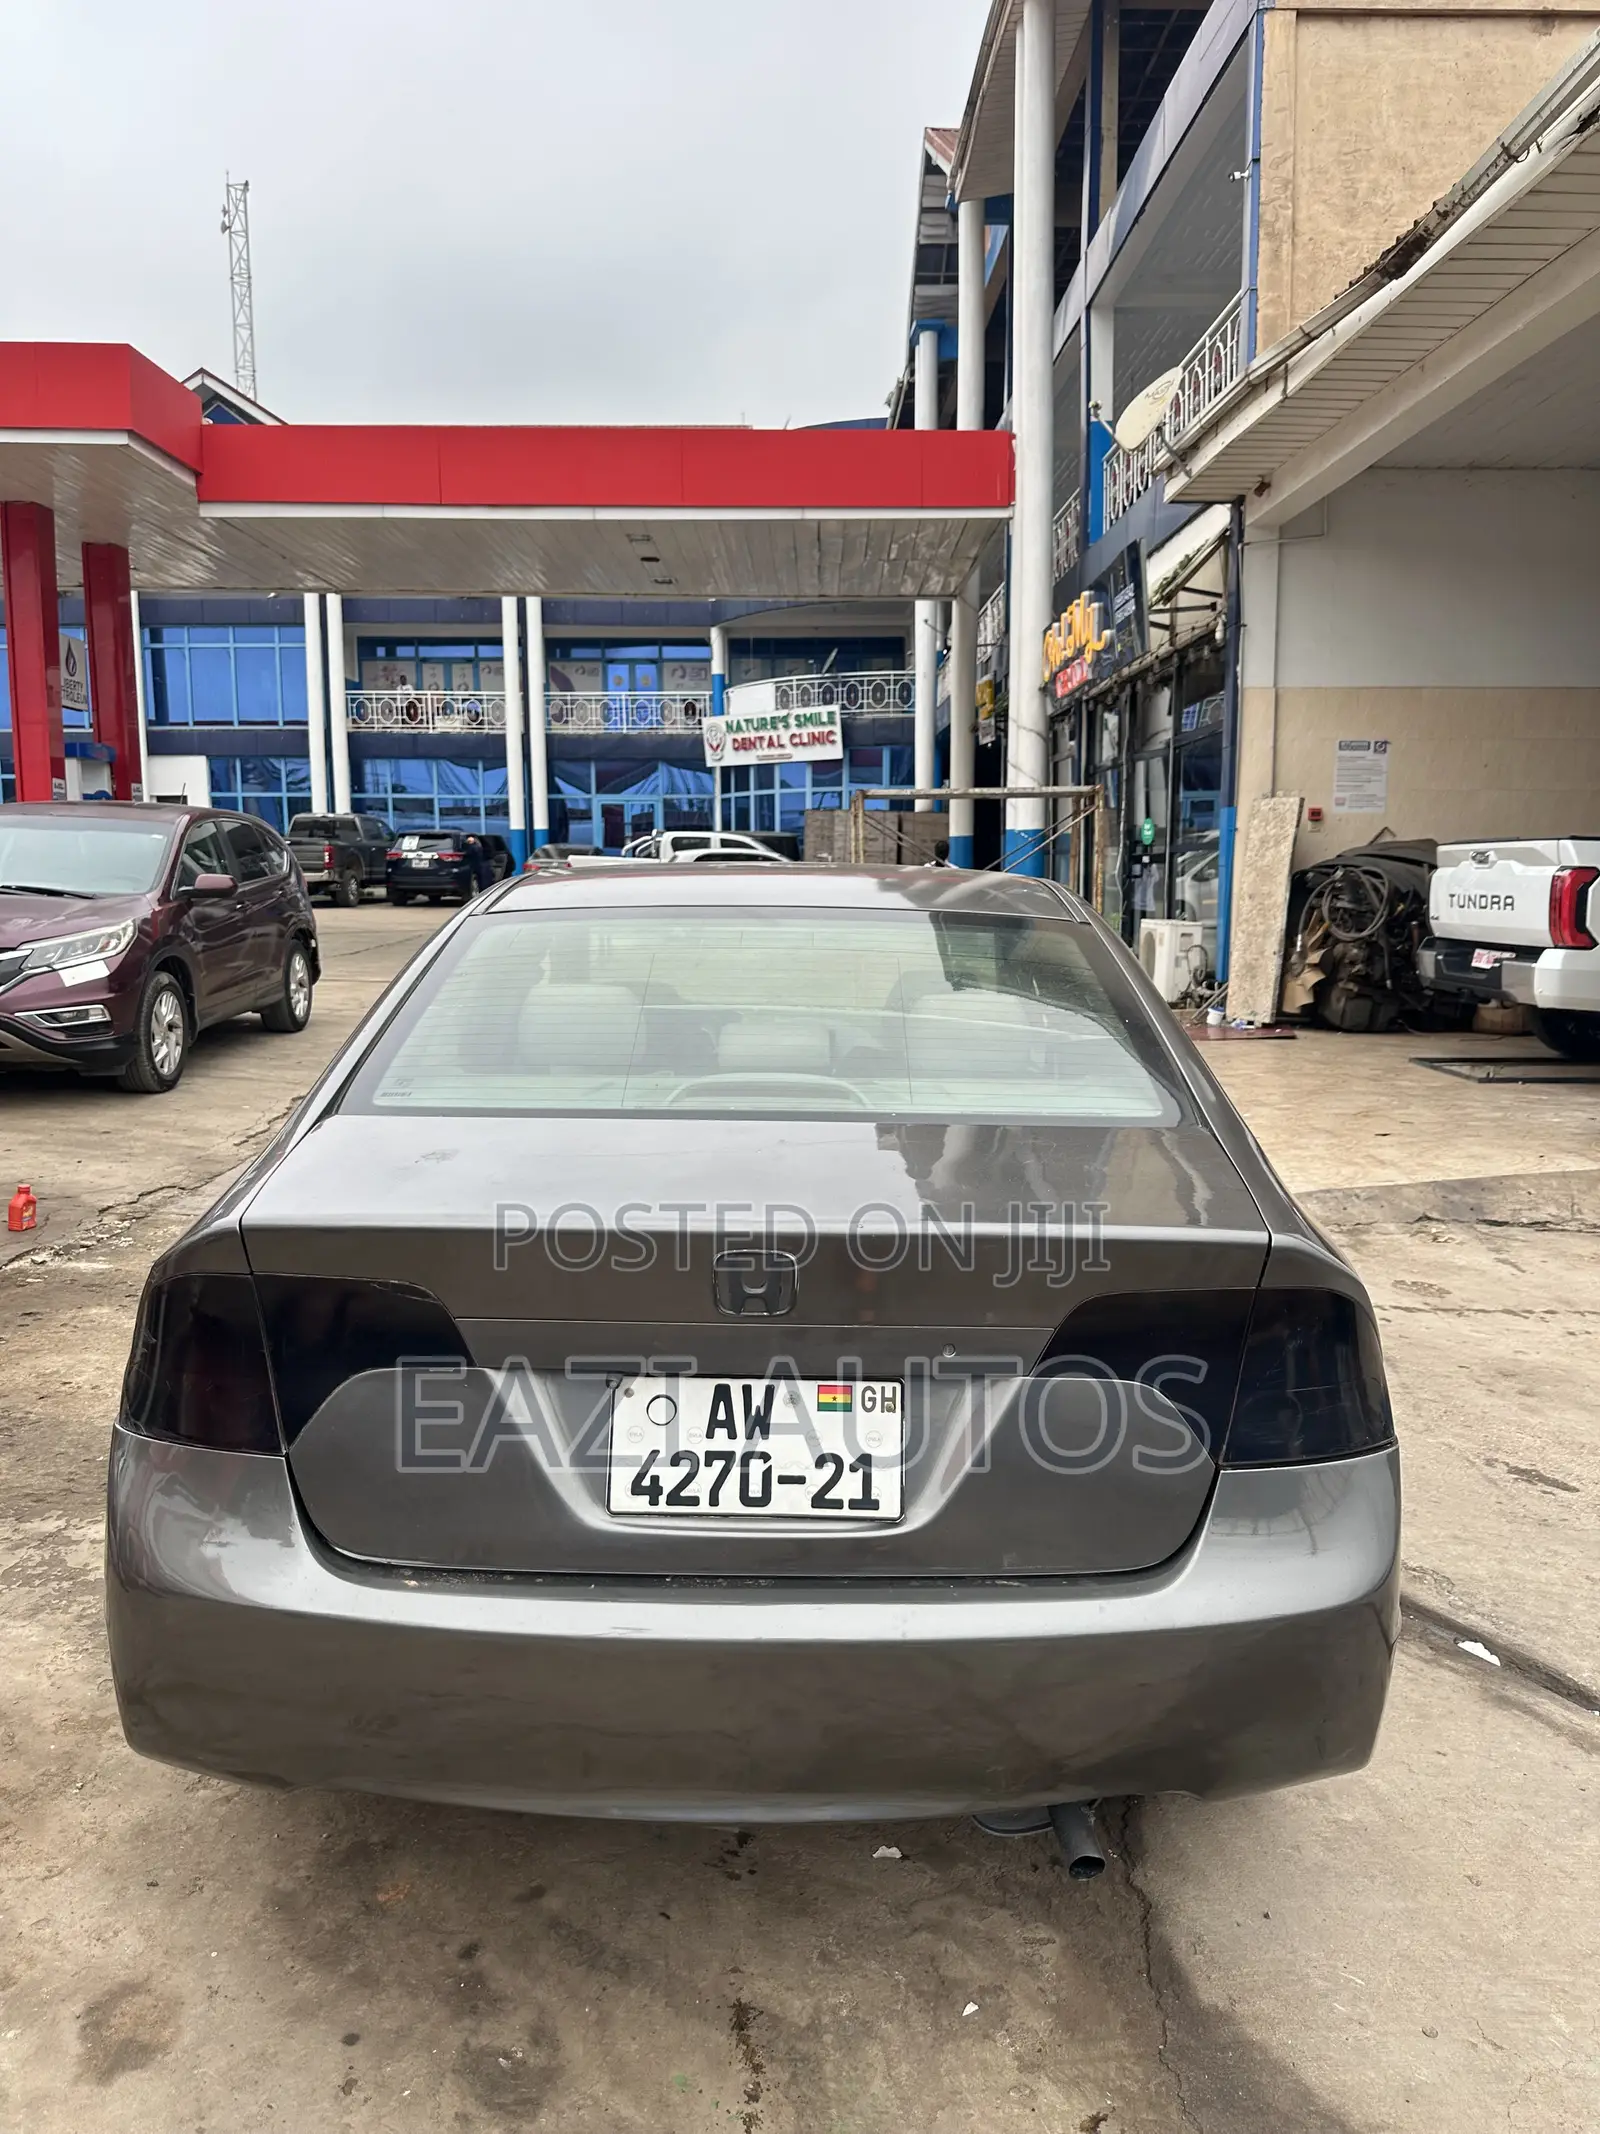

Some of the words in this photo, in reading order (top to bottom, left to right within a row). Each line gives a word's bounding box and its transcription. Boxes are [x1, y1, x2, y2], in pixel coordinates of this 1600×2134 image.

[725, 712, 790, 733] NATURE'S
[794, 710, 837, 729] SMILE
[732, 734, 786, 752] DENTAL
[789, 730, 837, 748] CLINIC
[1448, 893, 1515, 912] TUNDRA
[705, 1383, 775, 1440] AW
[861, 1385, 897, 1414] GH
[630, 1449, 880, 1511] 4270-21
